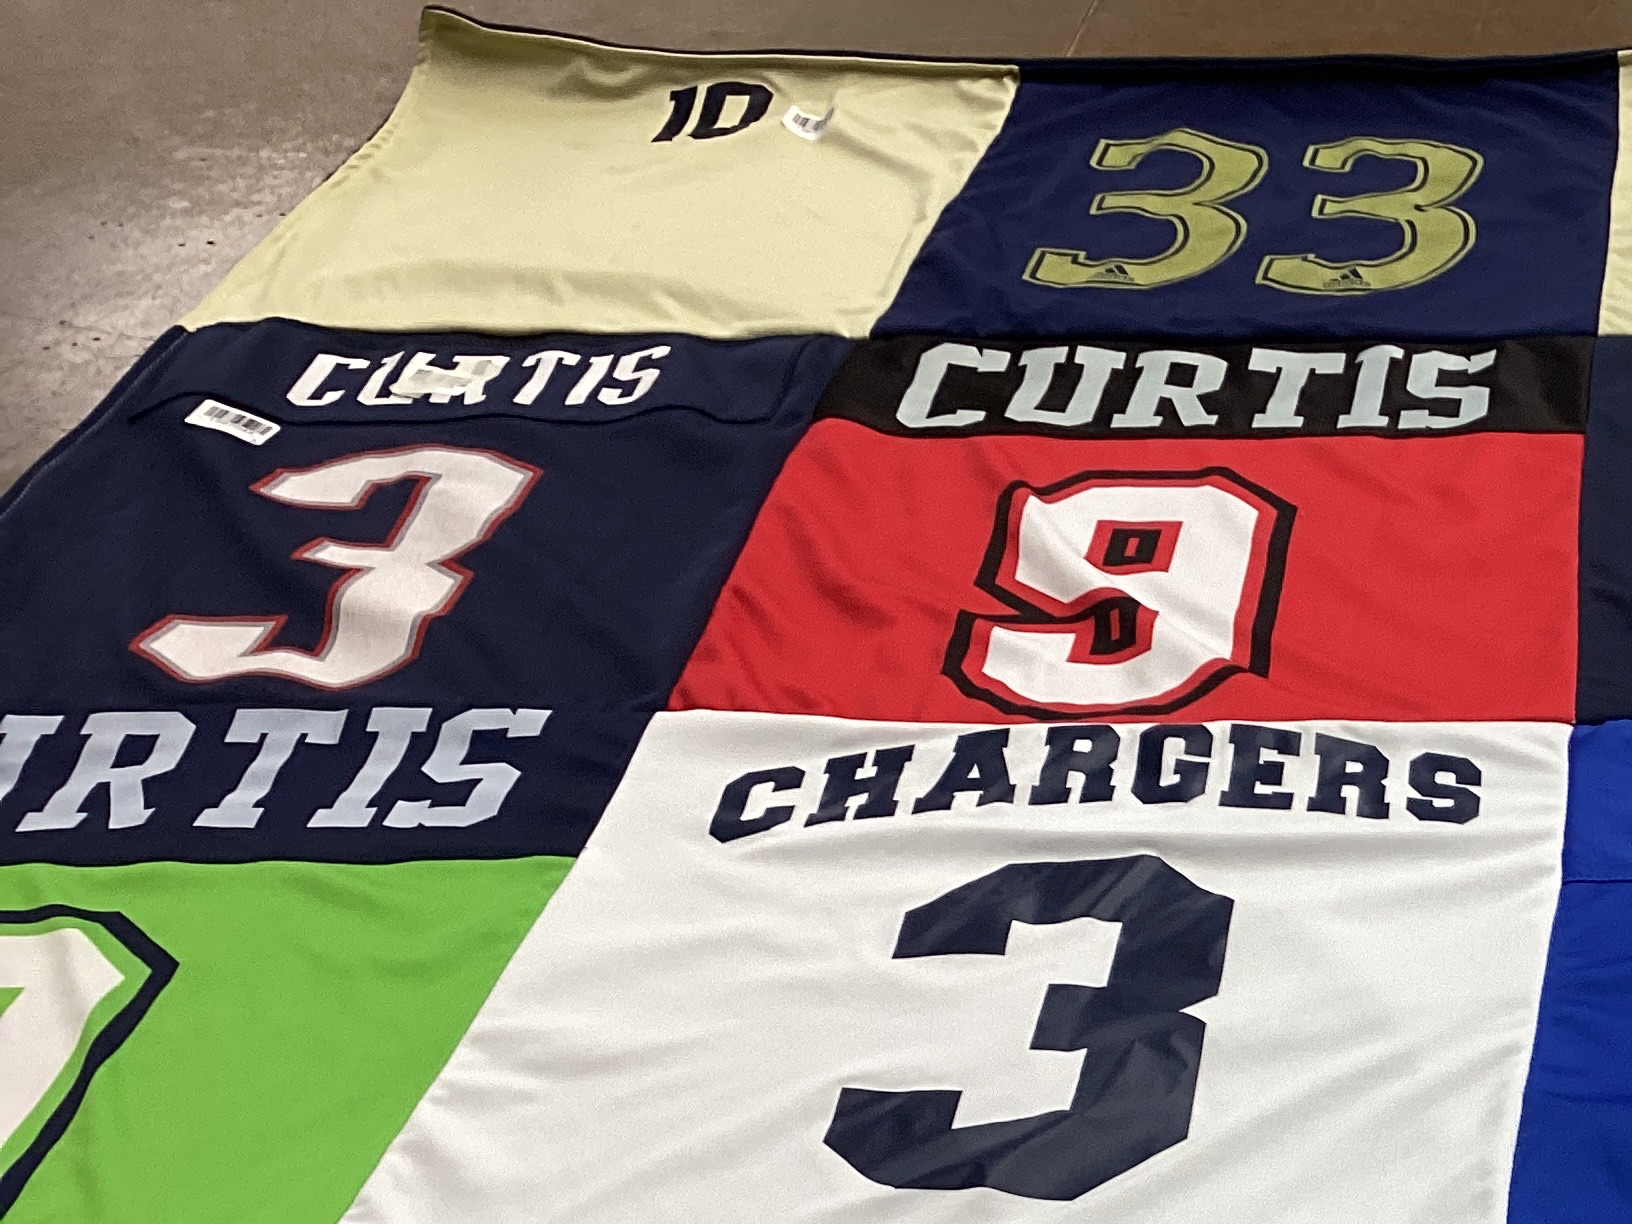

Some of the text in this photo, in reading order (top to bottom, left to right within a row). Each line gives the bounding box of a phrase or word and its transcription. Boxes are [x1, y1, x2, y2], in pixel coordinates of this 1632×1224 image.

[1022, 128, 1485, 295] 33
[285, 346, 672, 406] CURTIS
[895, 342, 1497, 430] CURTIS
[128, 443, 545, 690] 3
[940, 466, 1297, 722] 9
[708, 724, 1484, 844] CHARGERS
[822, 854, 1235, 1201] 3
